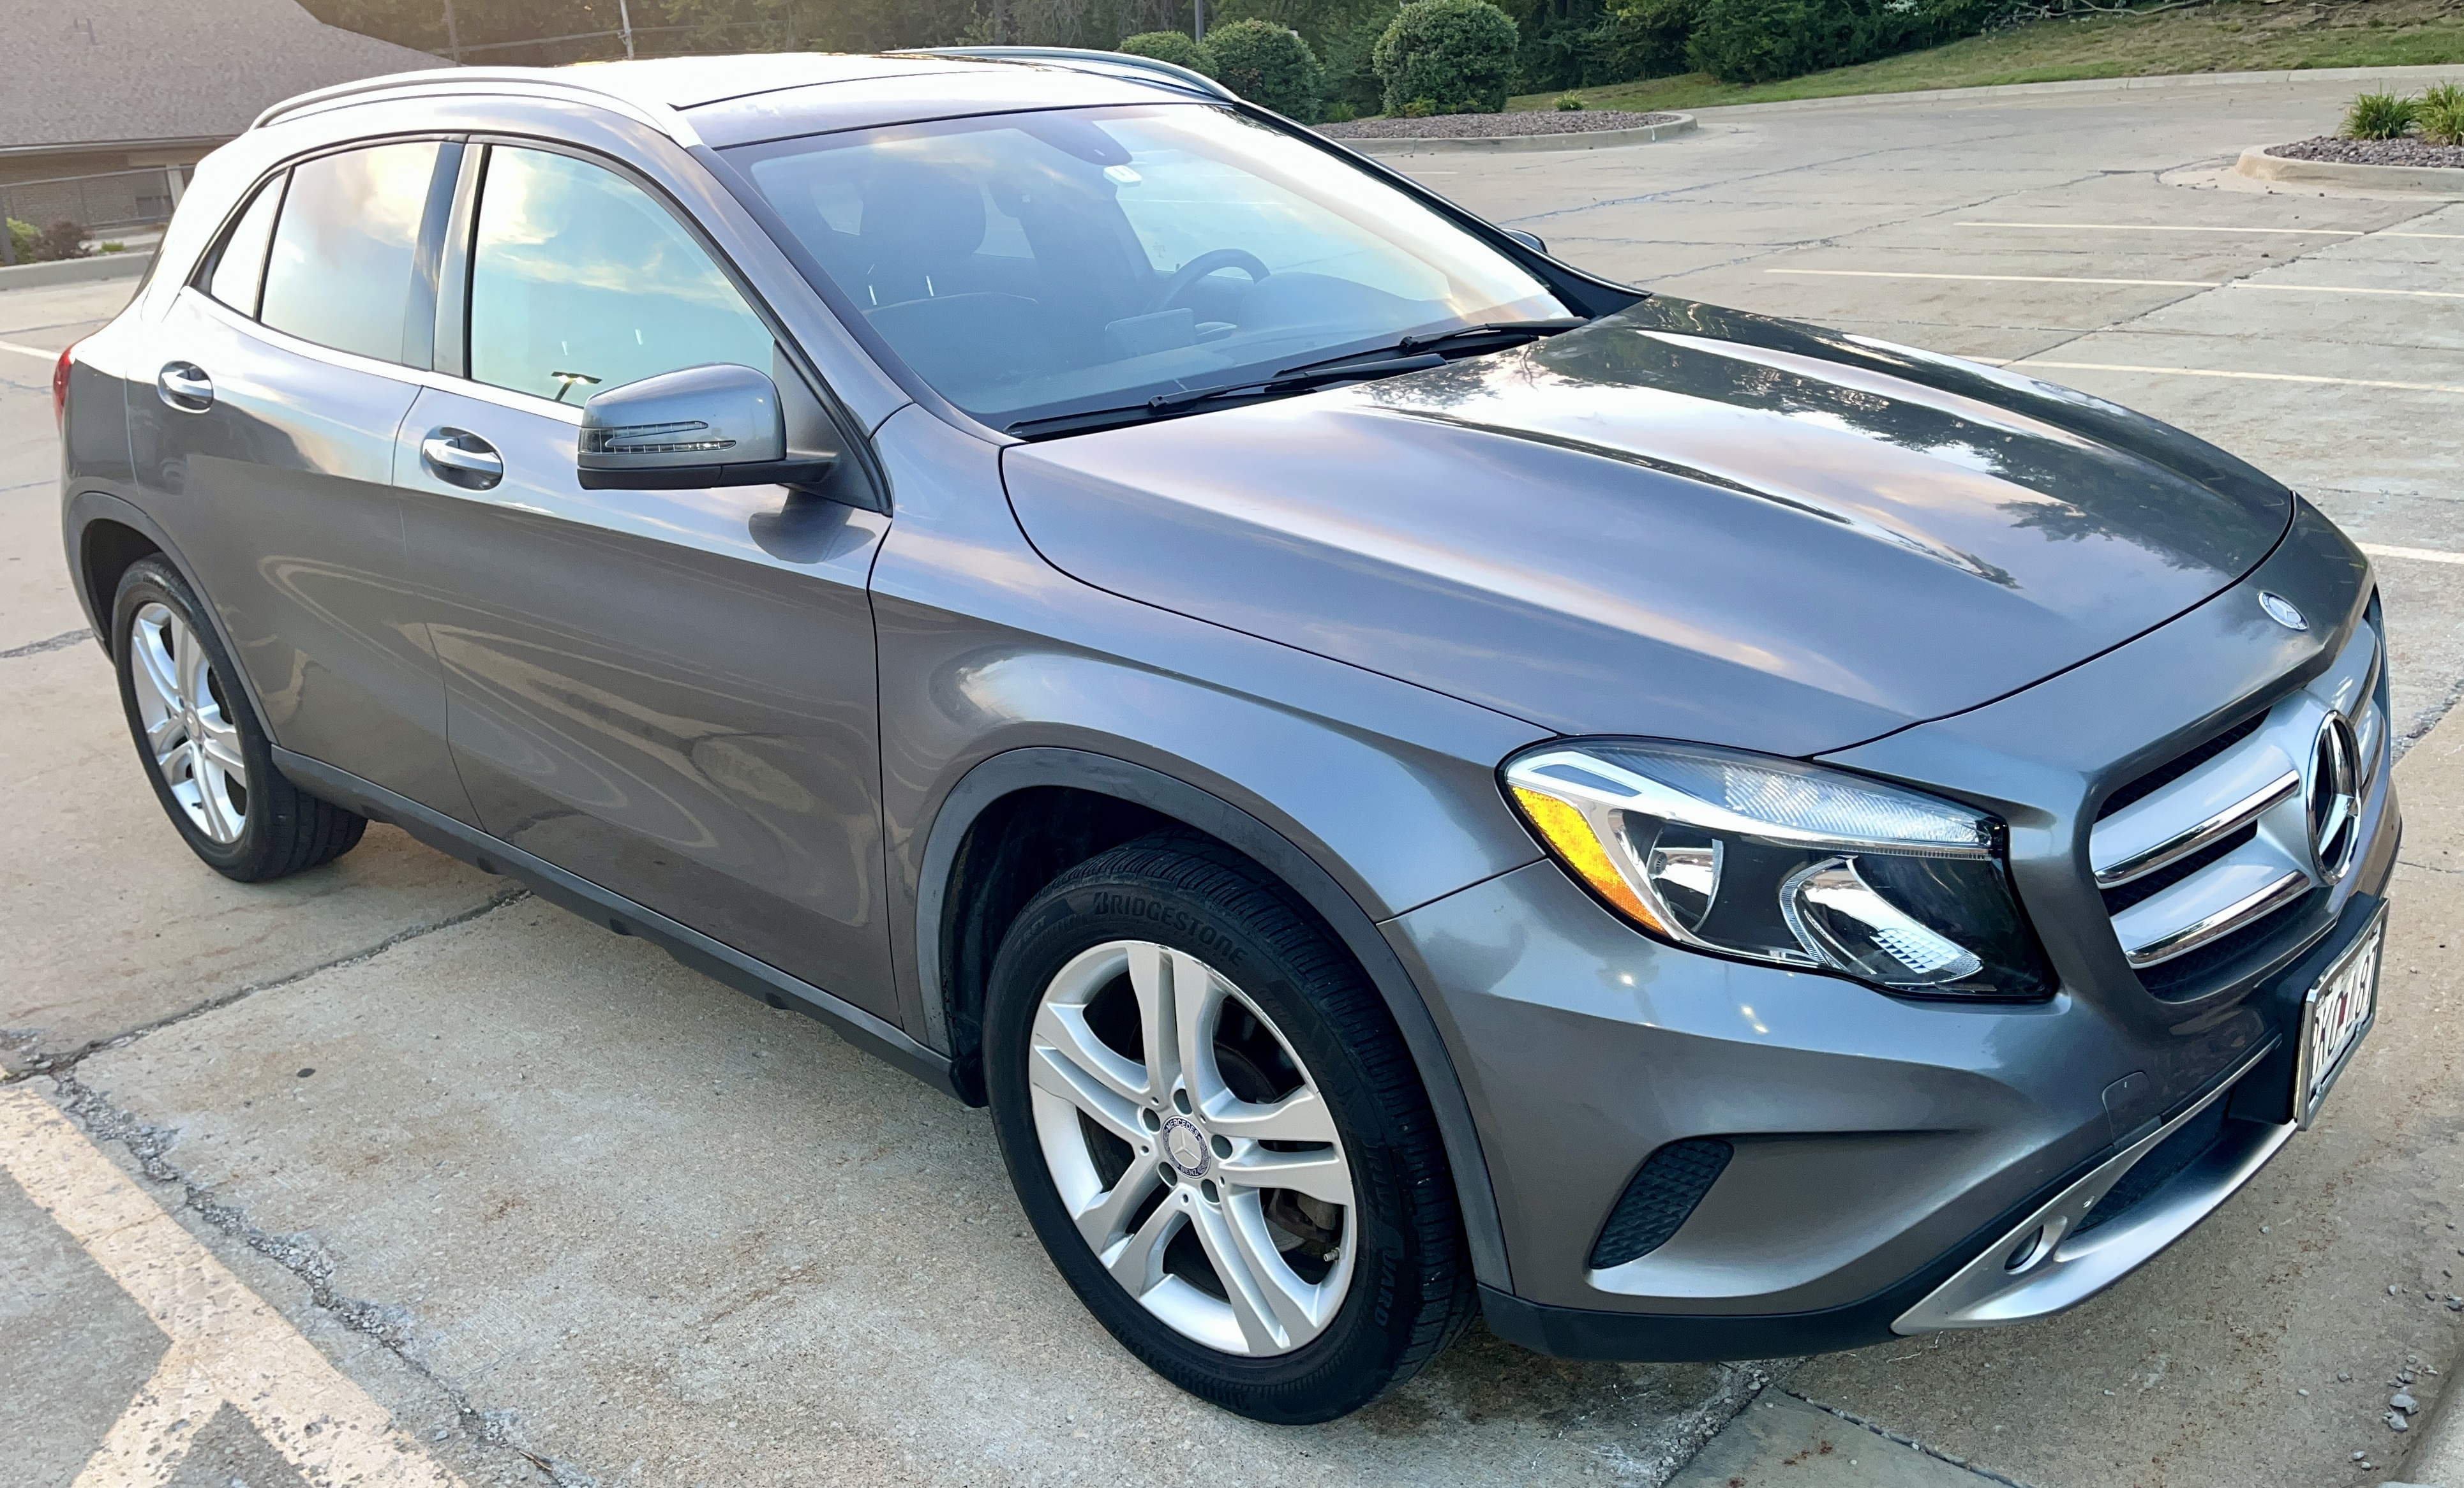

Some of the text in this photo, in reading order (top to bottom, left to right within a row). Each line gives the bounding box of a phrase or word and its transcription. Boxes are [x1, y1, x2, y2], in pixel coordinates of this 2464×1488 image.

[1092, 891, 1248, 966] BRIDGESTONE
[1166, 1119, 1199, 1137] MERCEDES
[1180, 1166, 1199, 1176] BENZ
